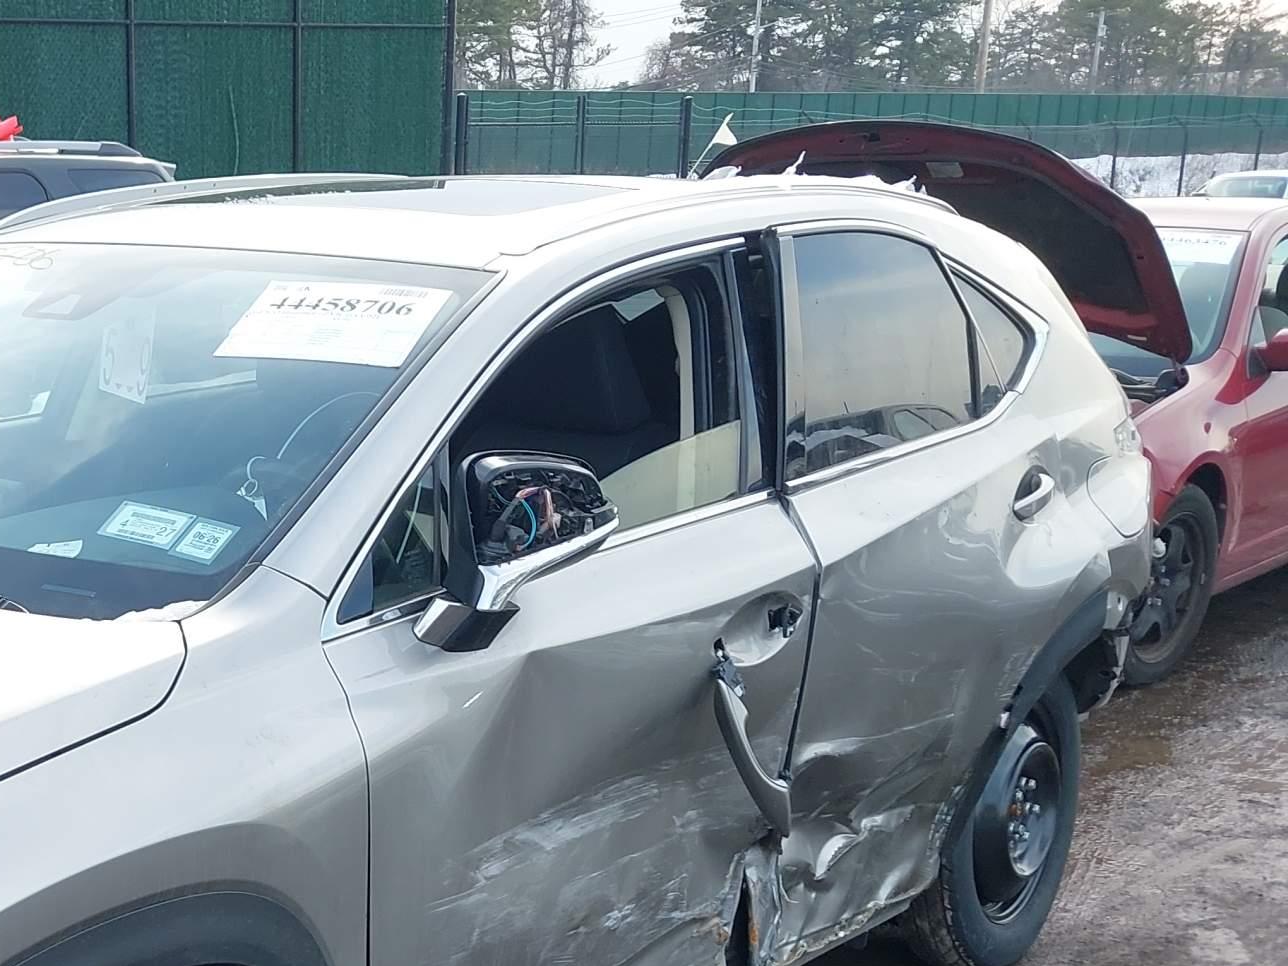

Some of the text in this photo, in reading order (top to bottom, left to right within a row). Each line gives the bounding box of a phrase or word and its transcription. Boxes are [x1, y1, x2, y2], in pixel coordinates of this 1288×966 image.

[269, 296, 417, 316] 44458706
[156, 526, 177, 538] 27
[192, 531, 222, 544] 06-26
